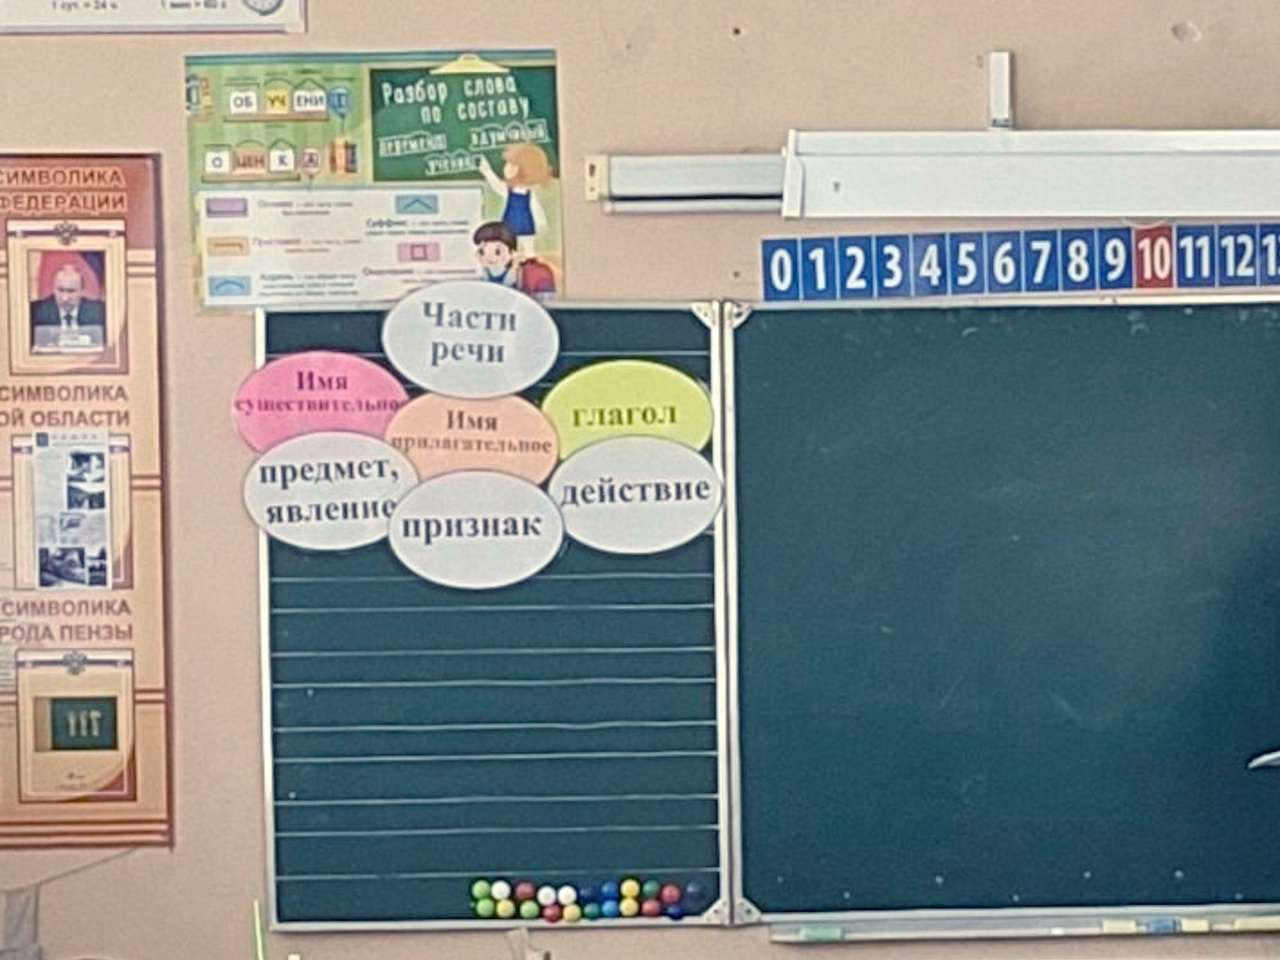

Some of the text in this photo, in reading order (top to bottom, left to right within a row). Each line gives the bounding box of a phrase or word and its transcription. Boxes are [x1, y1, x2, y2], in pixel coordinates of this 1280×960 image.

[381, 76, 517, 105] Разбор слова
[421, 97, 530, 124] по составу
[0, 170, 123, 186] ИМВОЛИКА
[770, 249, 792, 290] 0
[809, 248, 825, 290] 1
[845, 247, 867, 289] 2
[882, 245, 902, 288] 3
[919, 244, 941, 286] 4
[957, 243, 977, 285] 5
[993, 241, 1015, 284] 6
[1030, 240, 1052, 283] 7
[1066, 239, 1089, 282] 8
[1104, 238, 1126, 281] 9
[1138, 237, 1171, 280] 10
[1179, 236, 1210, 278] 11
[1221, 235, 1254, 277] 12
[423, 302, 517, 332] Части
[431, 340, 504, 366] речи
[297, 371, 348, 391] Имя
[0, 386, 129, 402] СИМВОЛИКА
[31, 410, 130, 428] ОБЛАСТИ
[235, 399, 404, 415] существительно
[572, 404, 677, 428] глагол
[447, 409, 498, 431] Имя
[392, 436, 553, 456] прилагательное
[259, 459, 399, 490] предмет,
[562, 477, 711, 508] действие
[266, 499, 397, 524] явление
[401, 515, 542, 545] признак
[2, 599, 132, 617] СИМВОЛИКА
[0, 624, 134, 643] РОДА ПЕНЗЫ
